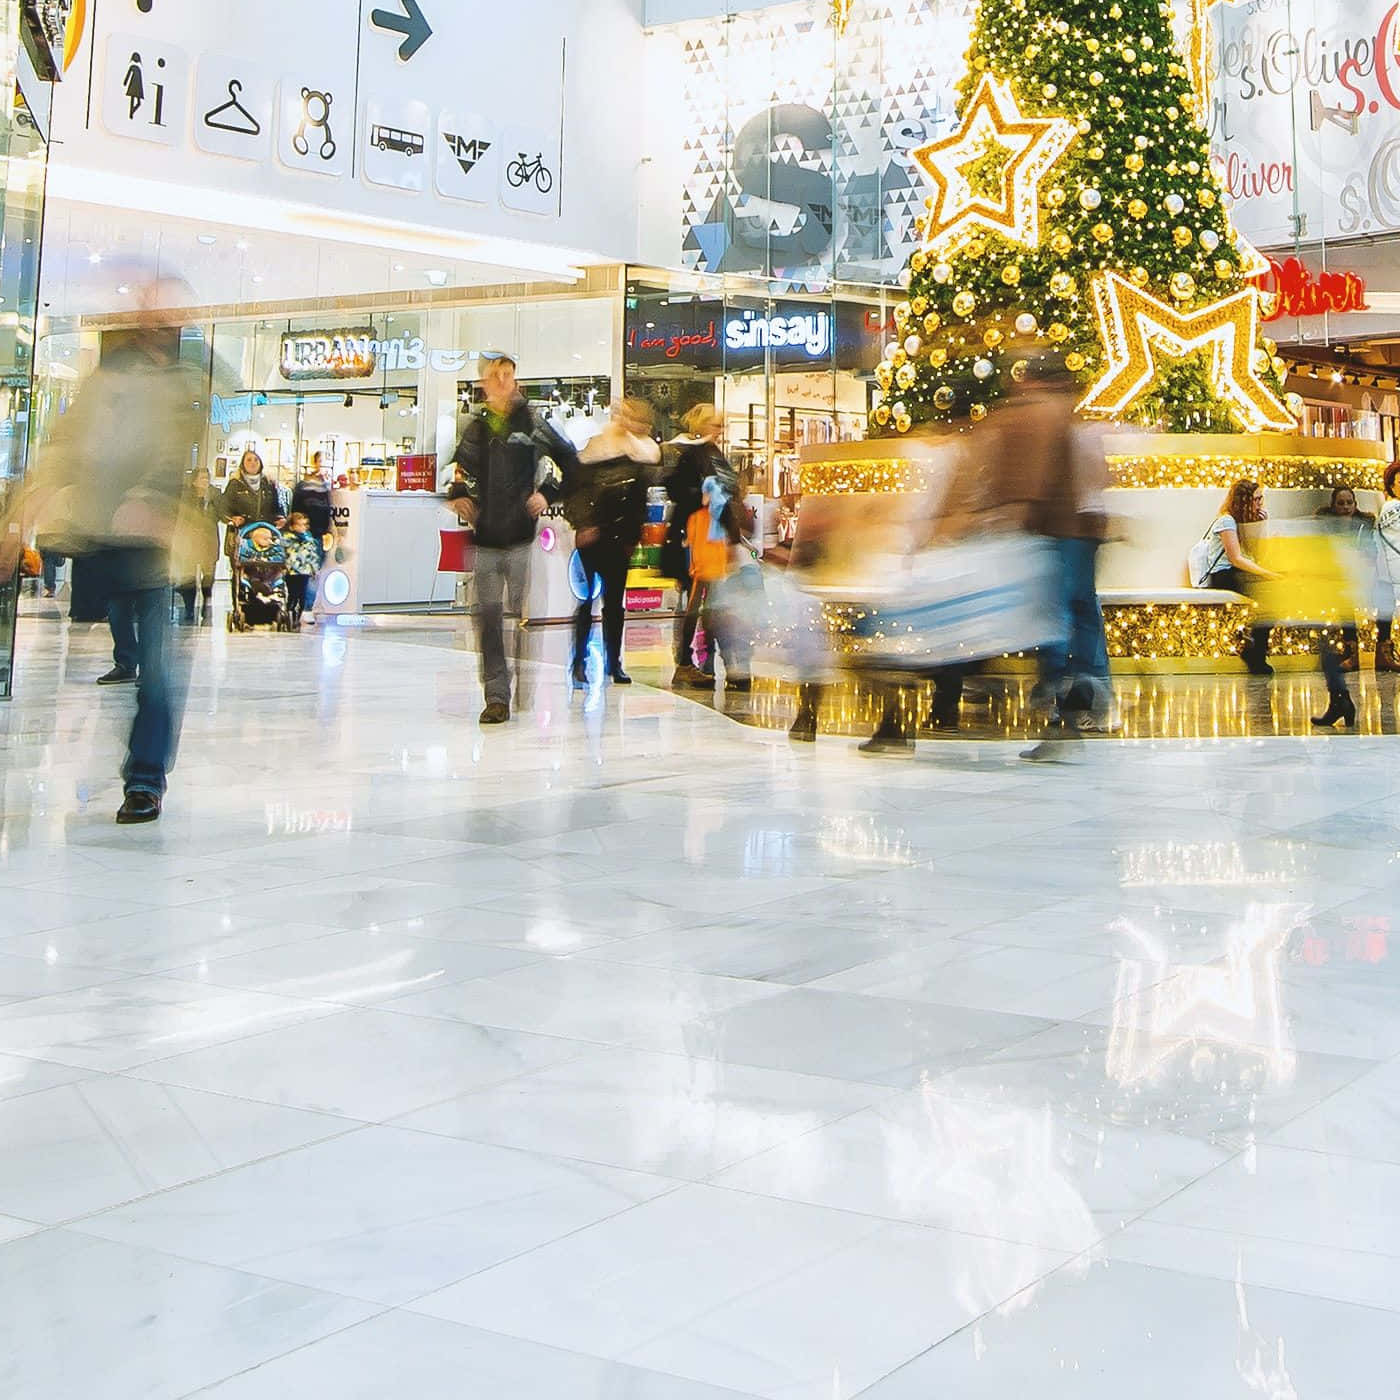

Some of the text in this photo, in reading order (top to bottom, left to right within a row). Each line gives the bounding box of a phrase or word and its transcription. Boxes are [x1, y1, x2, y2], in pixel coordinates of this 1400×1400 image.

[1239, 27, 1378, 100] s.Olive
[640, 337, 666, 349] am
[725, 311, 831, 356] sinsay
